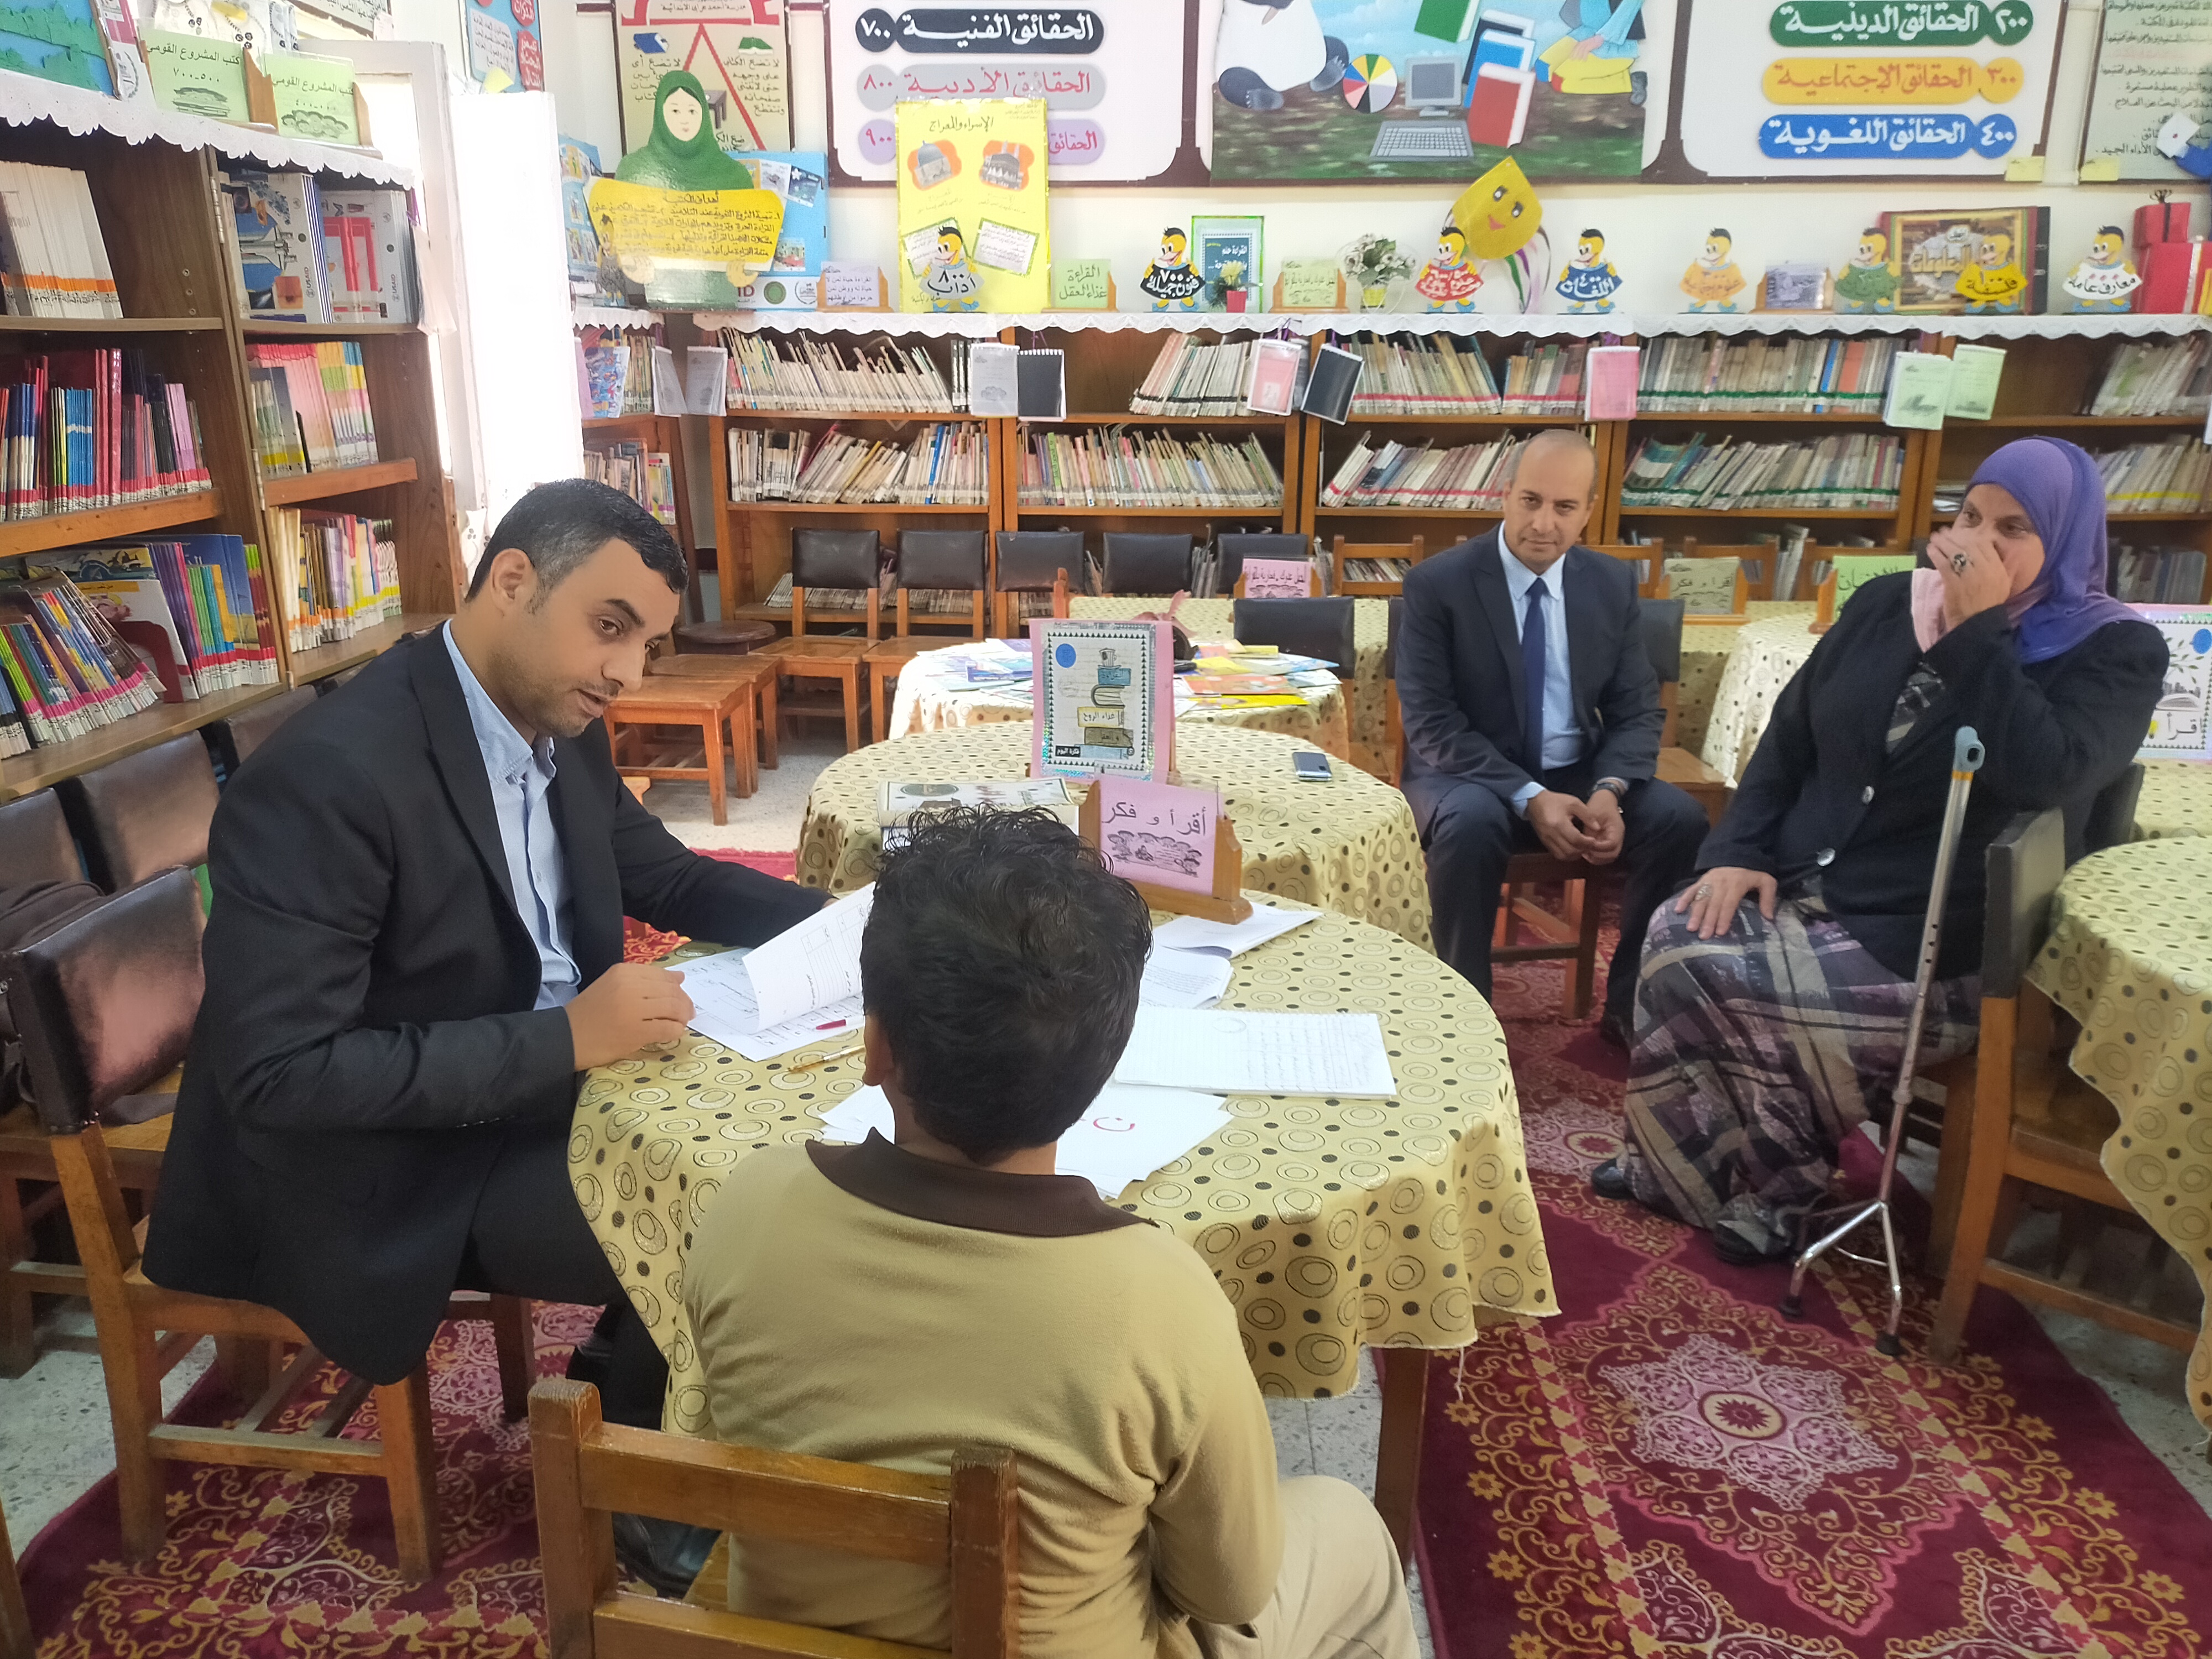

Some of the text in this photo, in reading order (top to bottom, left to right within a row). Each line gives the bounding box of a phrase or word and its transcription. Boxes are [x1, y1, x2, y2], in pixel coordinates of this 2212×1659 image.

[1778, 1, 2028, 41] الحقائق الدينية ٢٠٠
[859, 12, 1095, 49] الحقائق الفنية ٧٠٠
[179, 48, 220, 61] المشروع
[222, 55, 241, 66] كتب
[673, 58, 681, 67] لا
[649, 58, 672, 71] تضع
[301, 80, 337, 92] المشروع
[863, 74, 893, 91] ٨٠٠
[1012, 71, 1091, 98] الحقائق
[1773, 62, 2017, 97] الحقائق الإجتماعية ٣٠٠
[864, 128, 893, 147] ٩٠٠
[1767, 117, 2015, 155] الحقائق اللغوية ٤٠٠
[938, 270, 965, 284] ٨٠٠
[1067, 263, 1100, 283] القراءة
[1160, 269, 1184, 283] ٧٠٠
[1579, 272, 1601, 288] ٤٠٠
[1058, 283, 1108, 300] غذاء العقل
[1146, 274, 1199, 299] فنون جميلة
[1559, 276, 1615, 299] اللغات
[1083, 711, 1099, 722] الروح
[1056, 747, 1069, 757] اليوم
[1101, 802, 1137, 824] فكر
[1146, 816, 1160, 826] و
